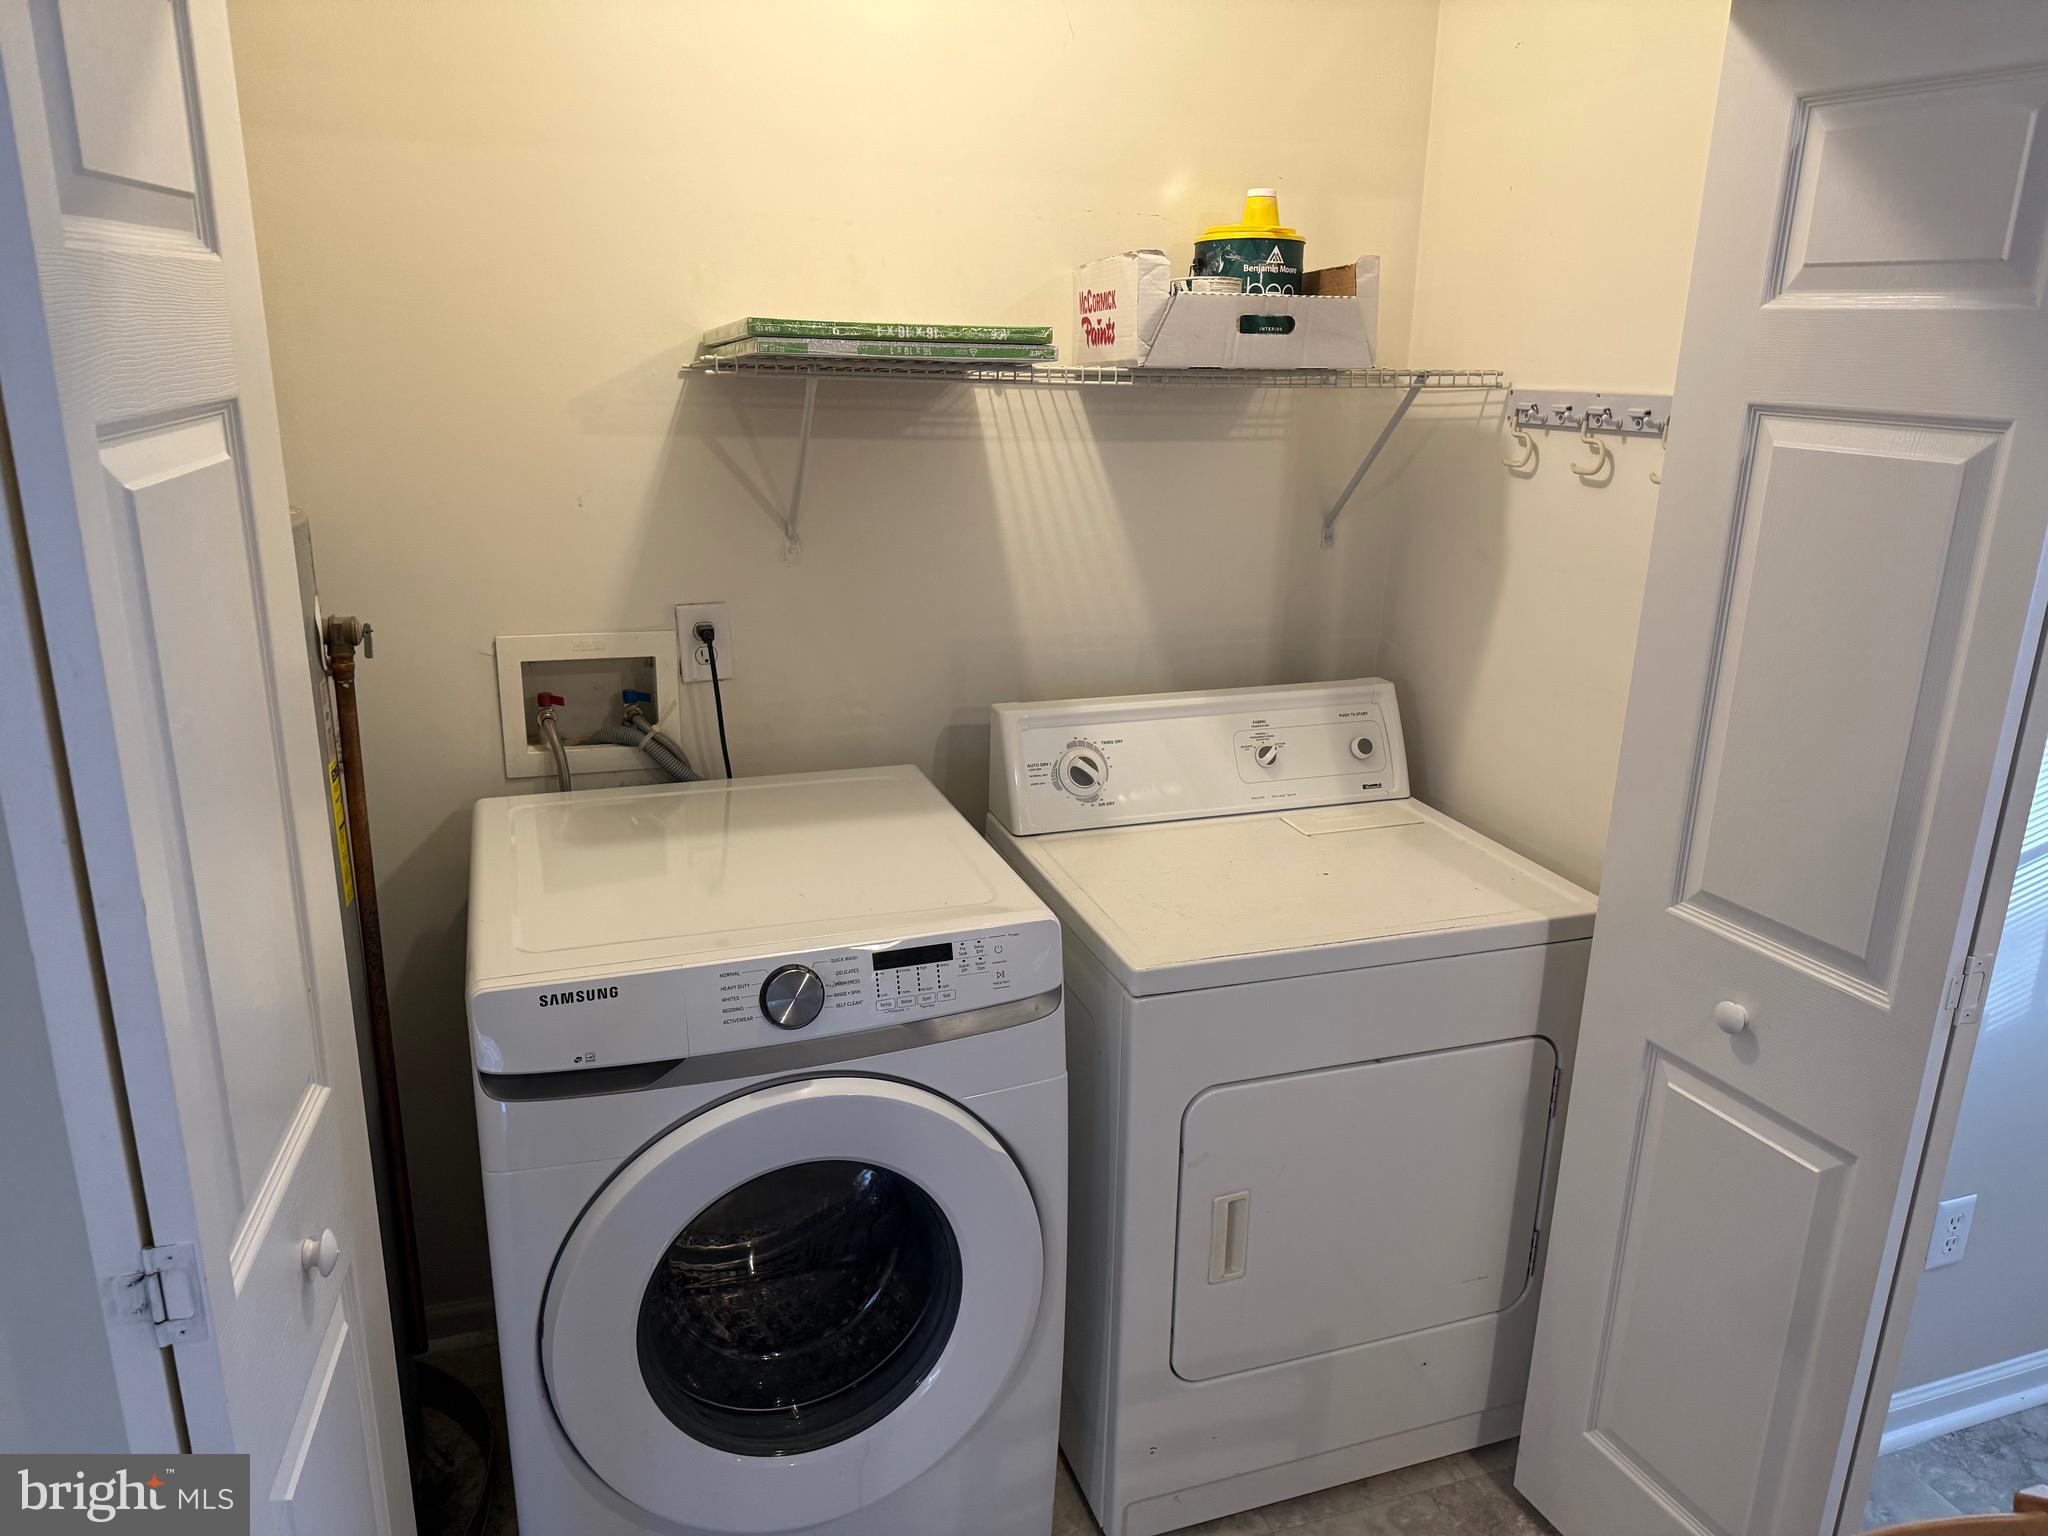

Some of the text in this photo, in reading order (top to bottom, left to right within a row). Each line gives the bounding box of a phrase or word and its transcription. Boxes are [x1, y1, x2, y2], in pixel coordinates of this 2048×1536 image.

[1243, 264, 1297, 274] Benjamin Moore
[1081, 316, 1116, 348] Paints
[835, 968, 859, 976] DELICATES
[539, 986, 619, 1007] SAMSUNG
[722, 1006, 744, 1014] BEDDING
[723, 1016, 754, 1024] ACTIVEWEAR
